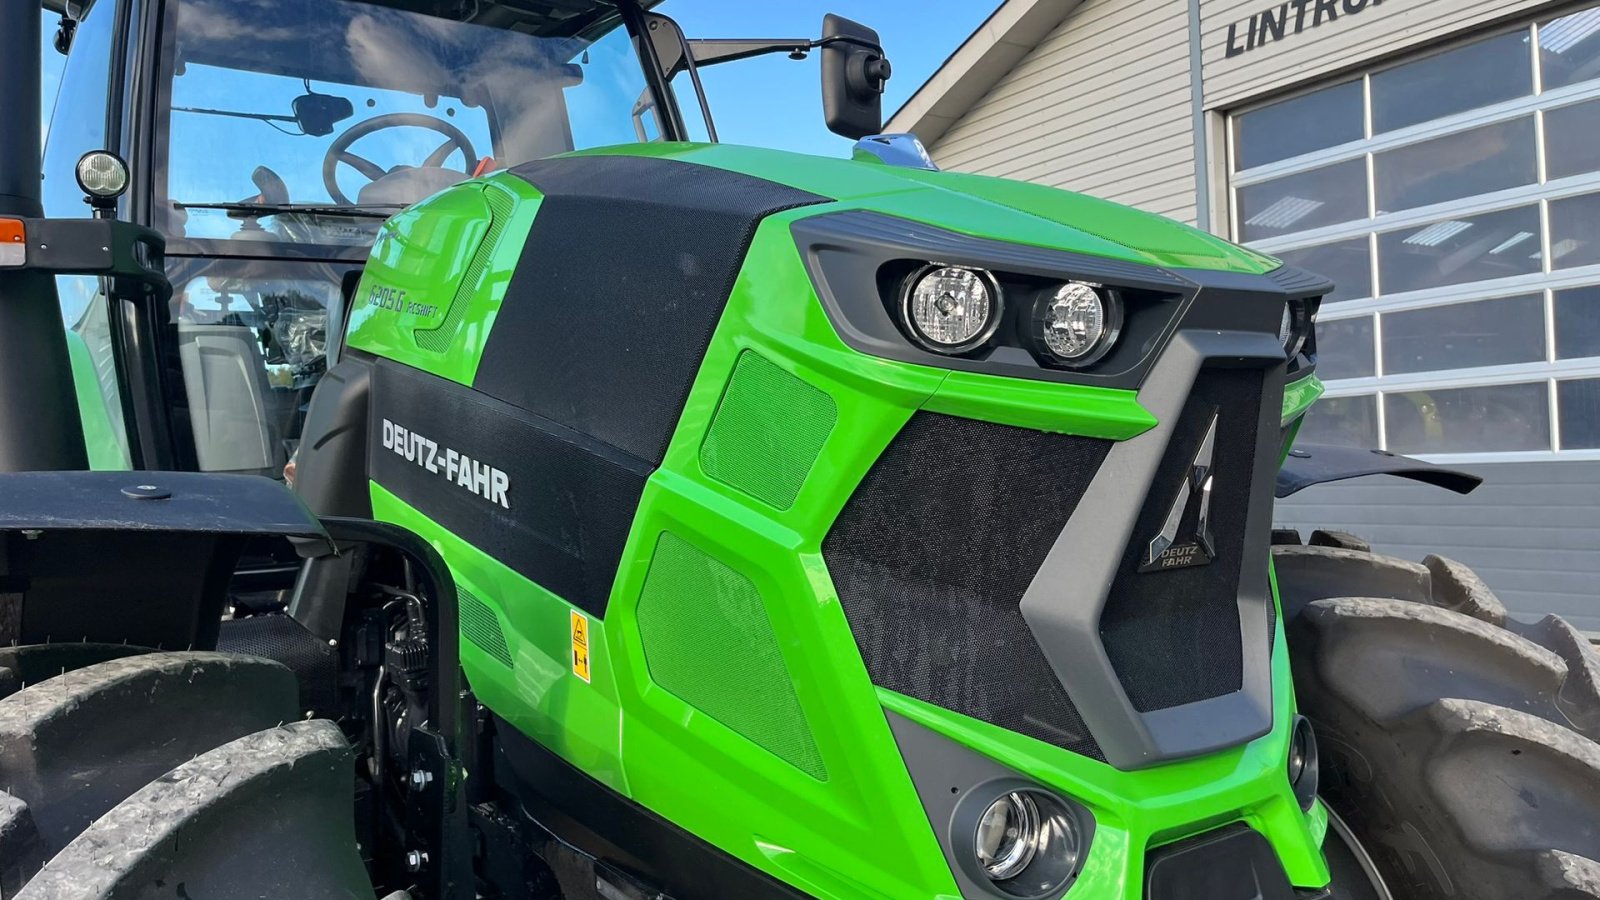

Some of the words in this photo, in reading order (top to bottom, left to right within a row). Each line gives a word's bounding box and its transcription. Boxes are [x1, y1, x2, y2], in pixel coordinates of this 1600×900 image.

[369, 285, 396, 310] 6205
[395, 290, 405, 312] G
[382, 418, 509, 509] DEUTZ-FAHR
[1161, 546, 1198, 558] DEUTZ
[1162, 556, 1192, 567] FAHR
